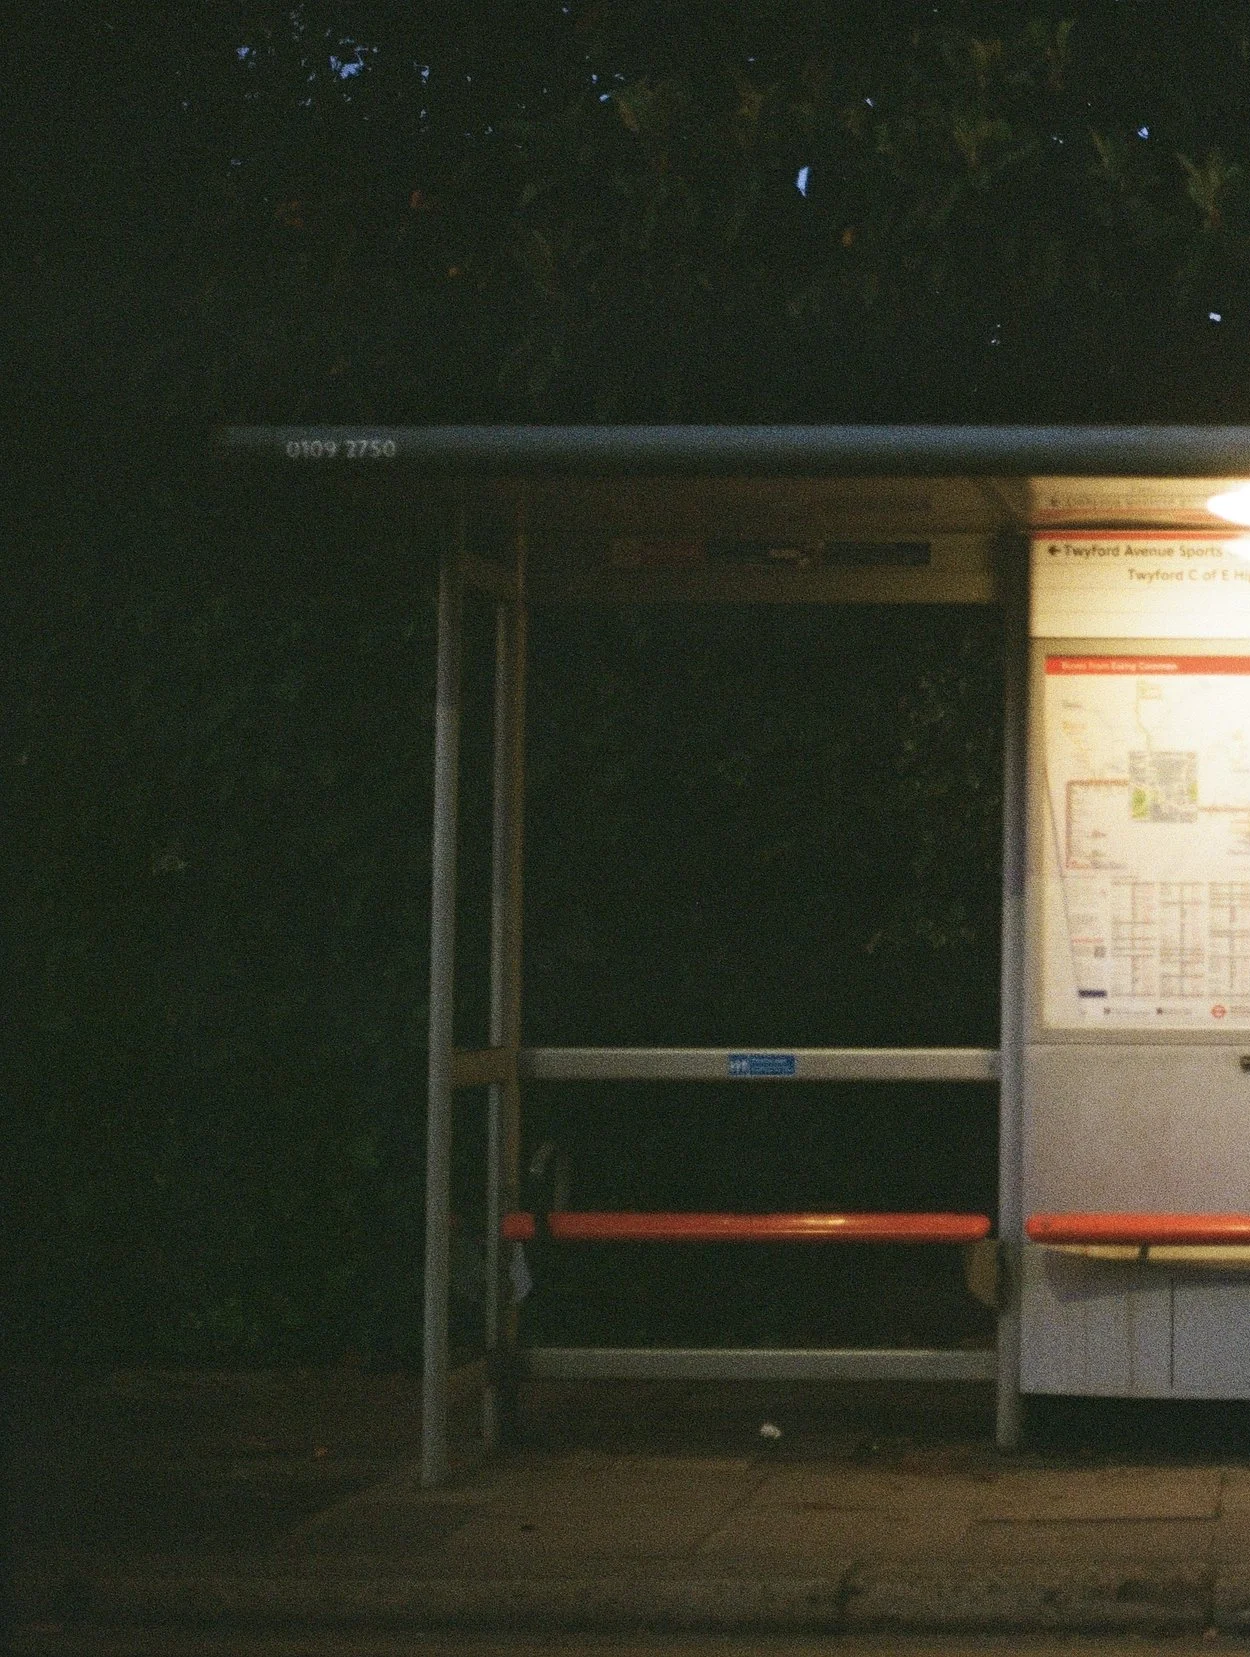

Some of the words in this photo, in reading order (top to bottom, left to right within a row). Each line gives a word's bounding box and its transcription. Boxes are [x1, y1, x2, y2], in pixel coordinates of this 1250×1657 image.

[286, 440, 337, 458] 0109
[345, 439, 396, 458] 2750
[1064, 544, 1120, 560] Twyford
[1124, 545, 1175, 557] Avenue
[1179, 545, 1223, 559] Sports
[1128, 569, 1184, 583] Twyford
[1188, 569, 1198, 580] C
[1202, 569, 1217, 581] of
[1221, 569, 1230, 580] E
